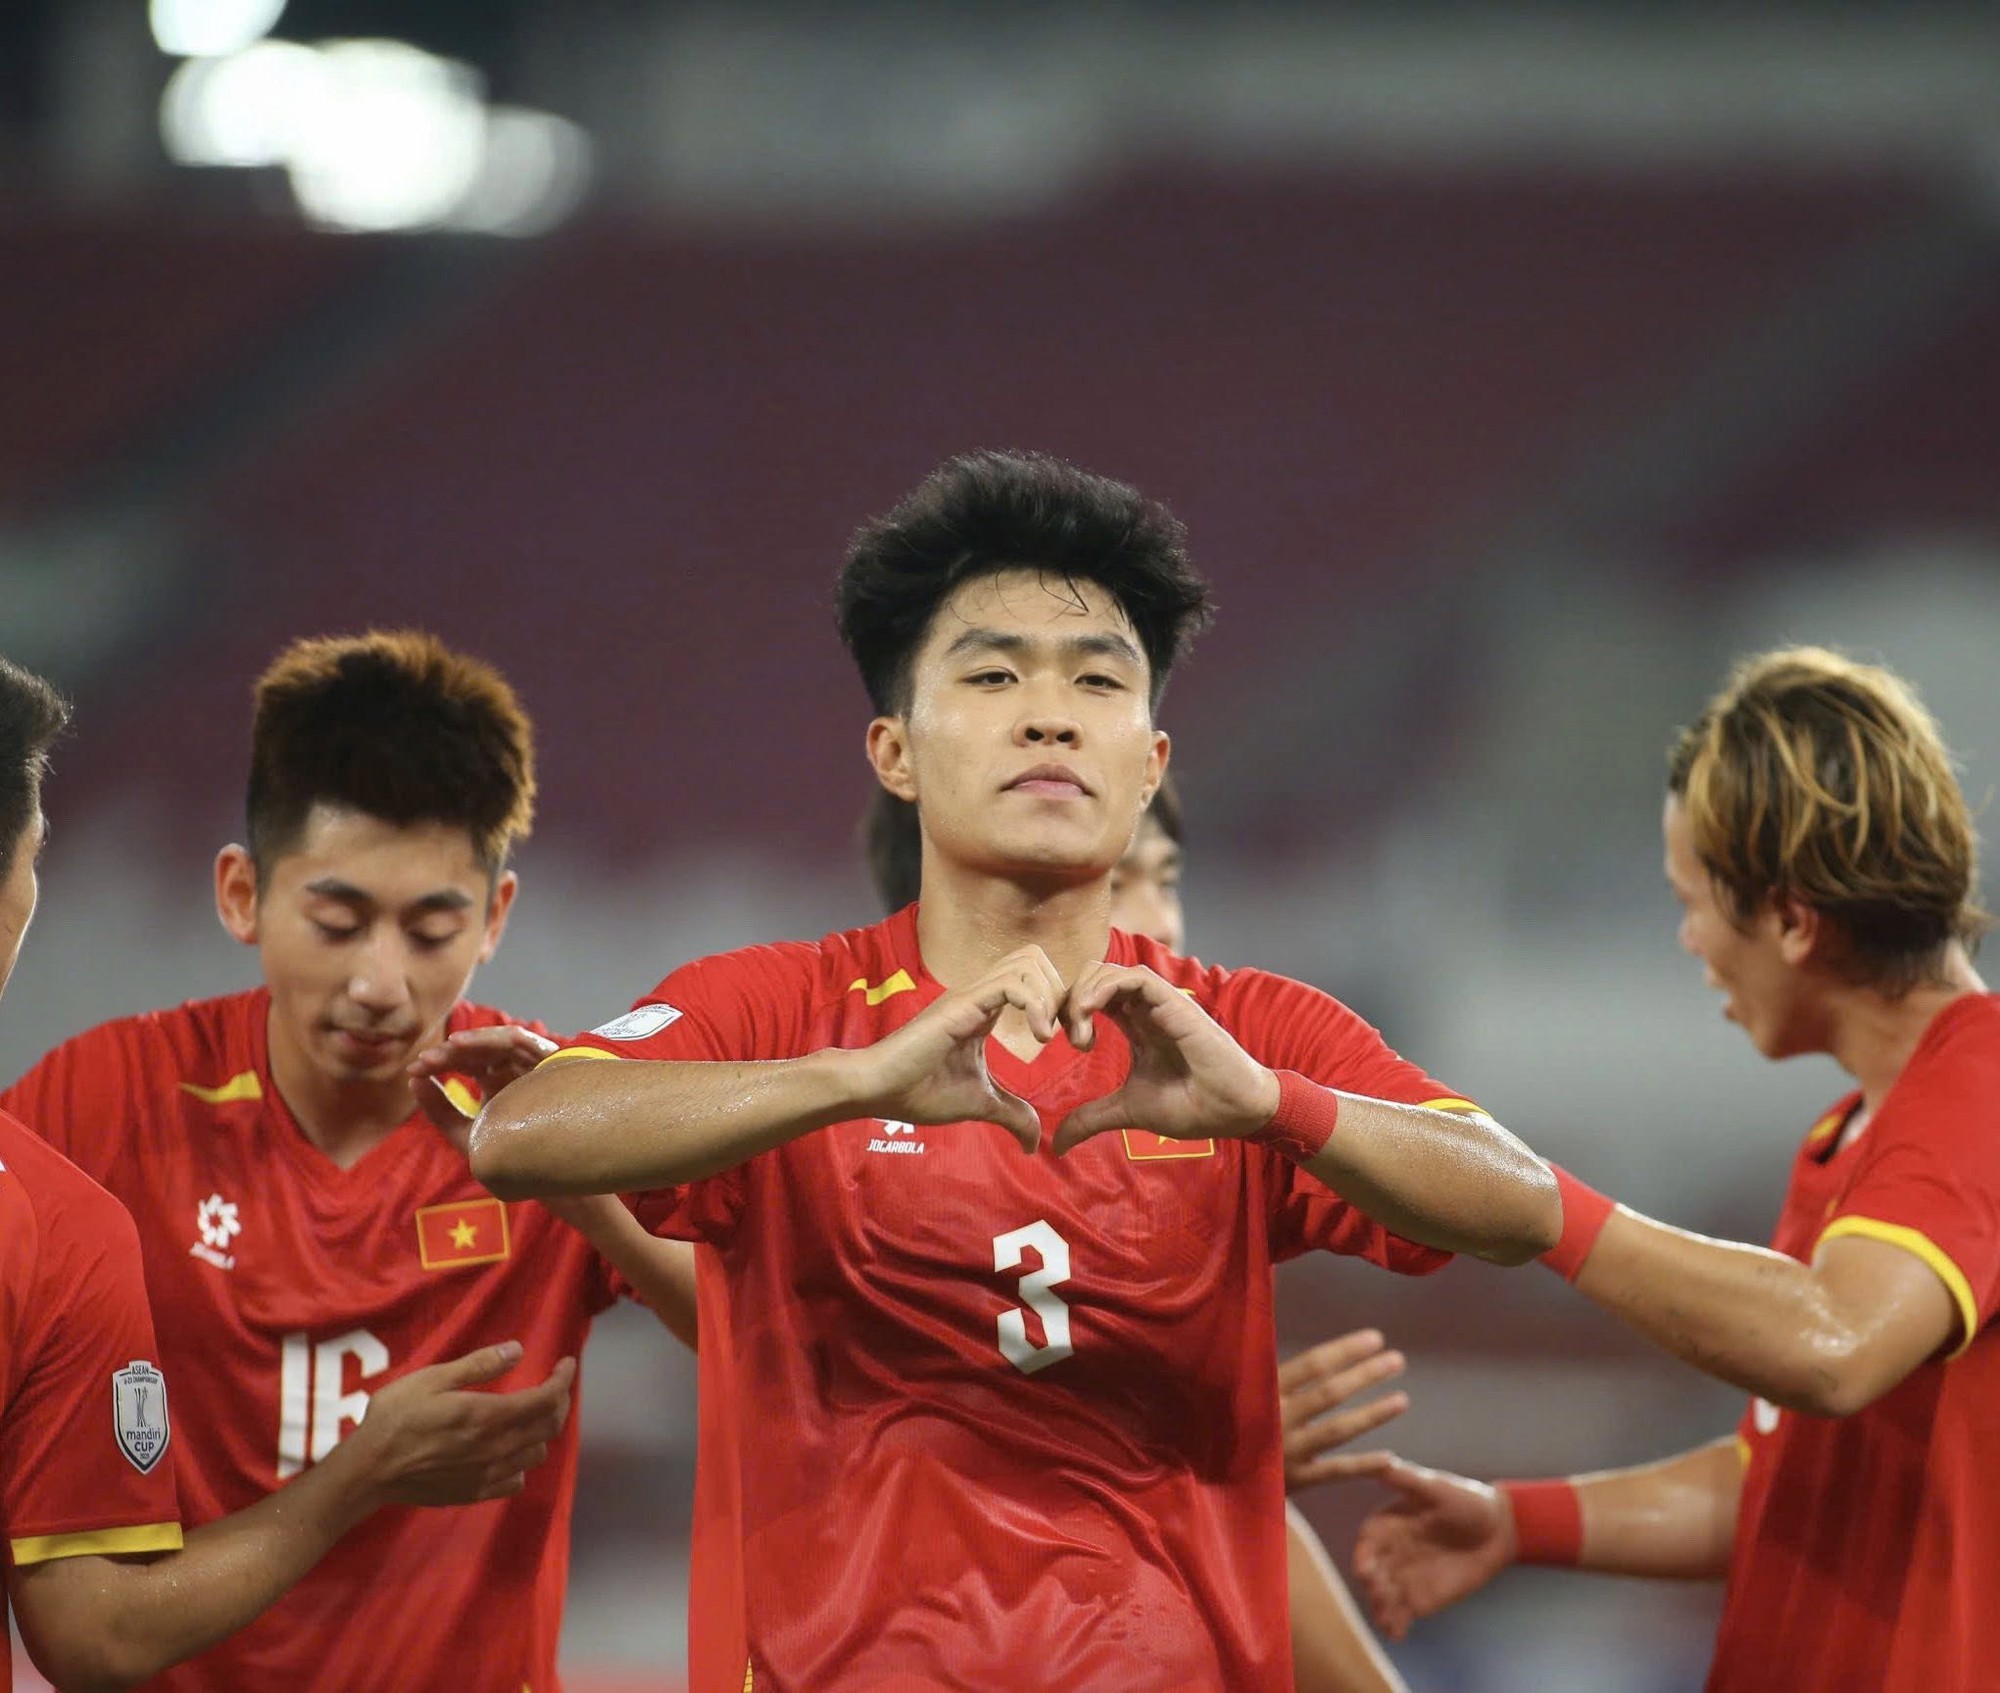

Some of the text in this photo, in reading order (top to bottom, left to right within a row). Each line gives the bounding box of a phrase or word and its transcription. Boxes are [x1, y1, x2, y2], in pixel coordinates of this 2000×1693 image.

[993, 1219, 1075, 1375] 3
[132, 1365, 149, 1375] ASEAN
[277, 1330, 389, 1479] 16
[126, 1427, 161, 1441] mandiri
[134, 1441, 155, 1452] CUP
